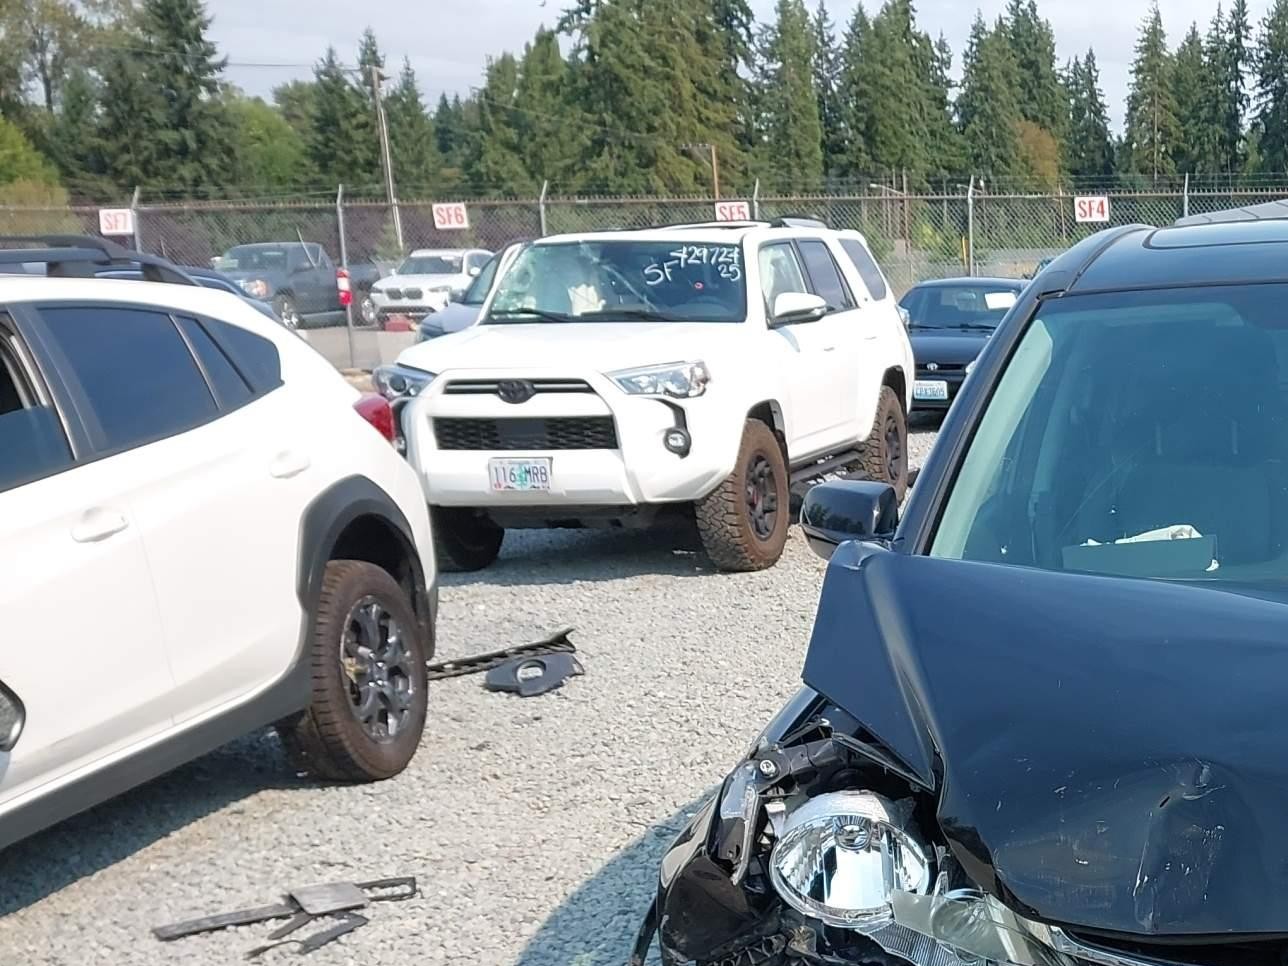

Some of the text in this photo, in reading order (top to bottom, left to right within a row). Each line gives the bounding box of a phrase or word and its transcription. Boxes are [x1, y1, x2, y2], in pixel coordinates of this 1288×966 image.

[436, 206, 465, 225] SF6
[719, 205, 747, 221] SF5
[1078, 200, 1105, 218] SF4
[104, 213, 128, 230] SF7
[643, 260, 680, 285] SF
[717, 264, 740, 282] 25
